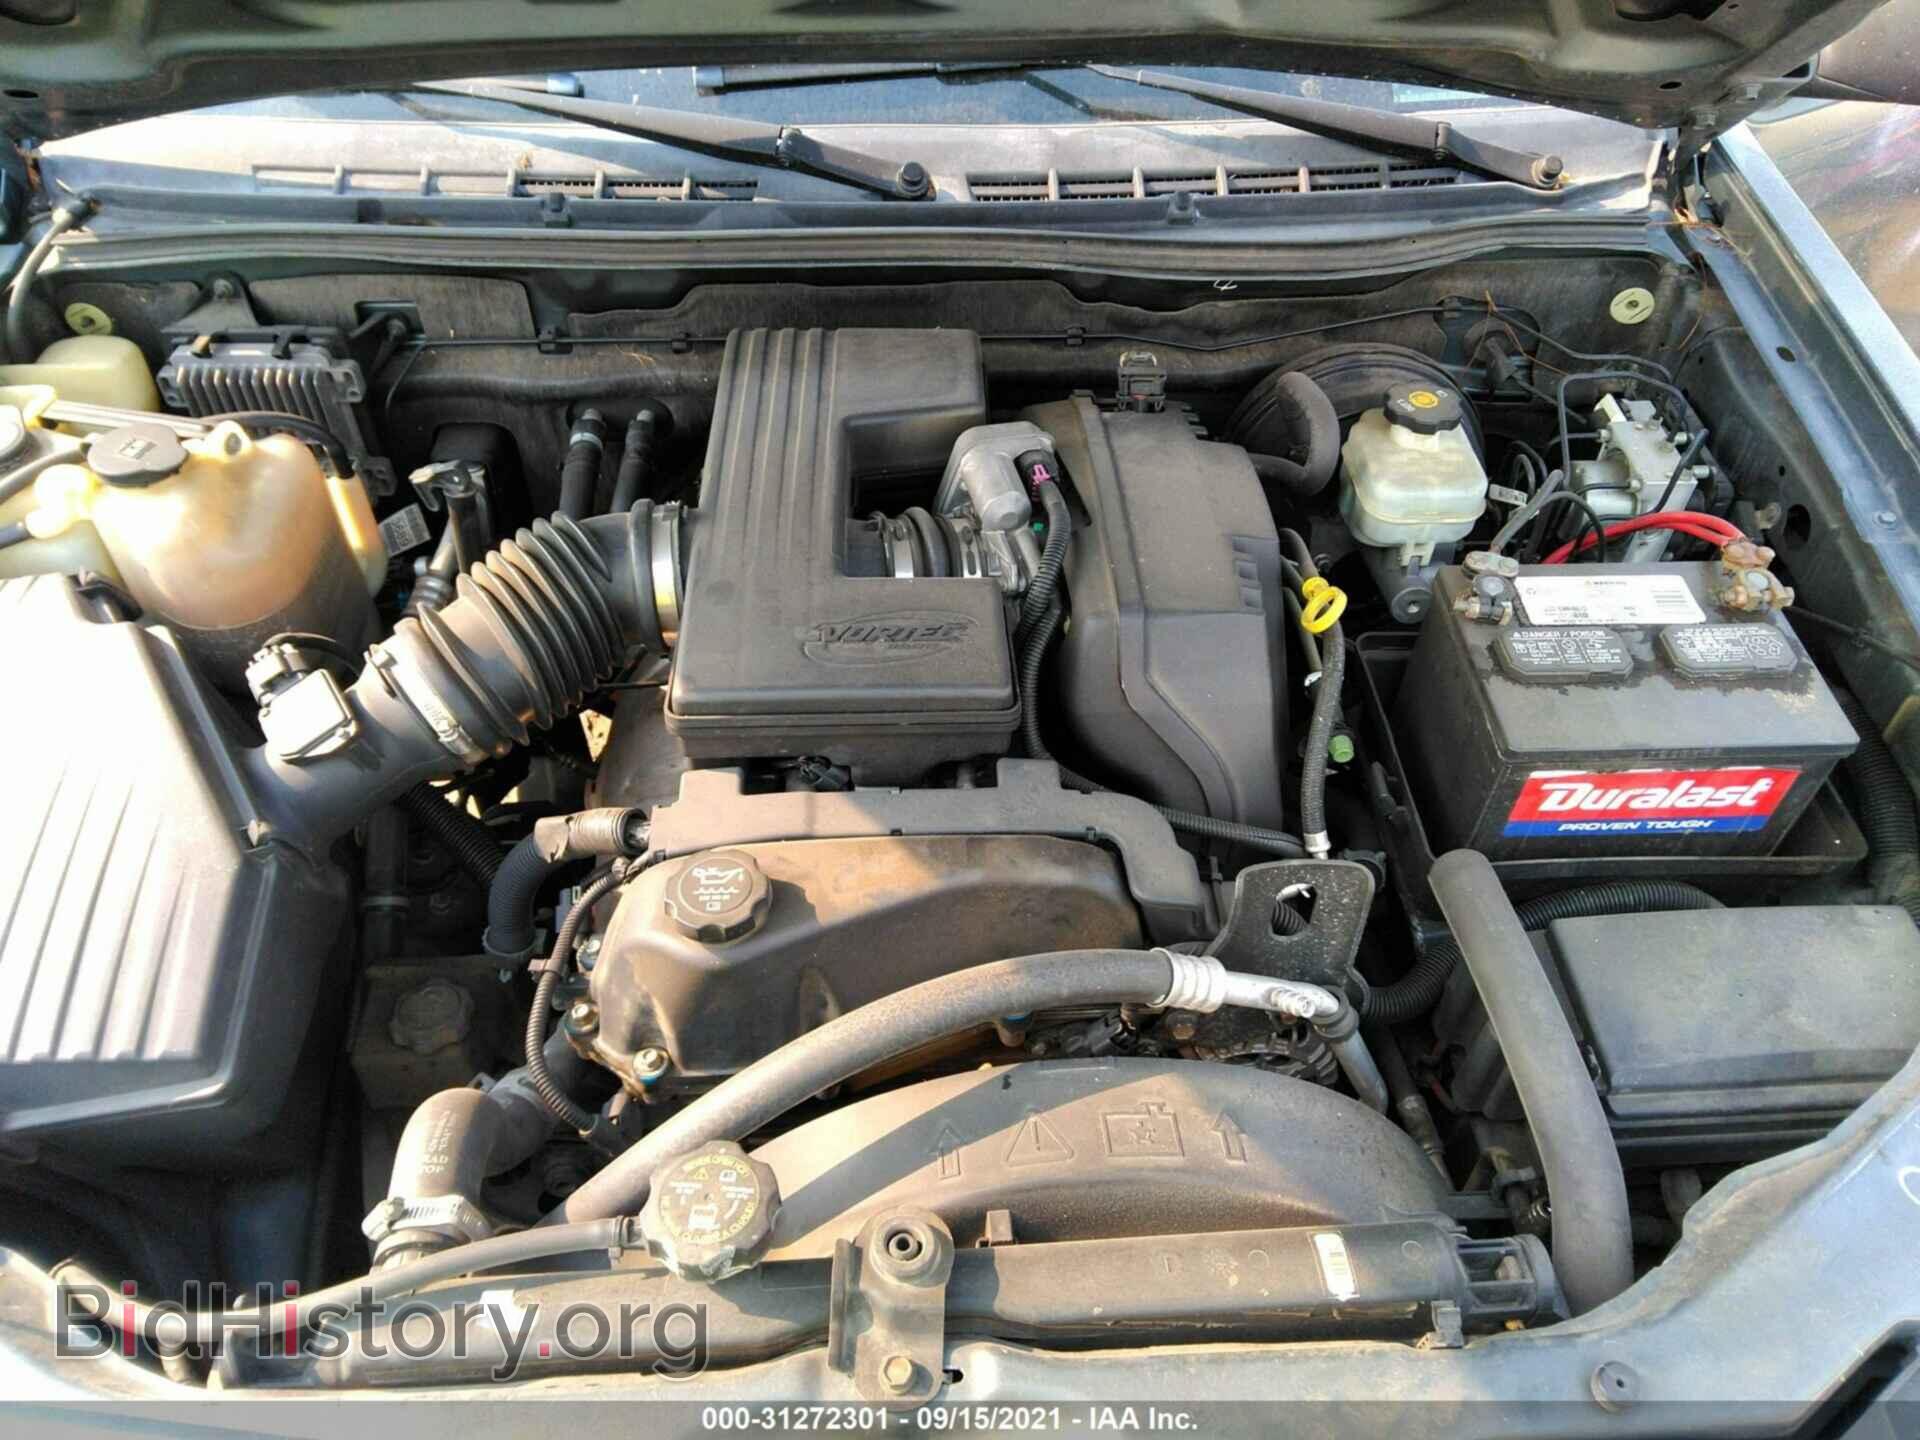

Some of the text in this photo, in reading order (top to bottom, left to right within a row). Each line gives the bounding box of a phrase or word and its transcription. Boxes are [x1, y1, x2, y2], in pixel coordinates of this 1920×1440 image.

[1539, 779, 1774, 812] Duralast
[1558, 820, 1714, 832] PROVEN TOUGH
